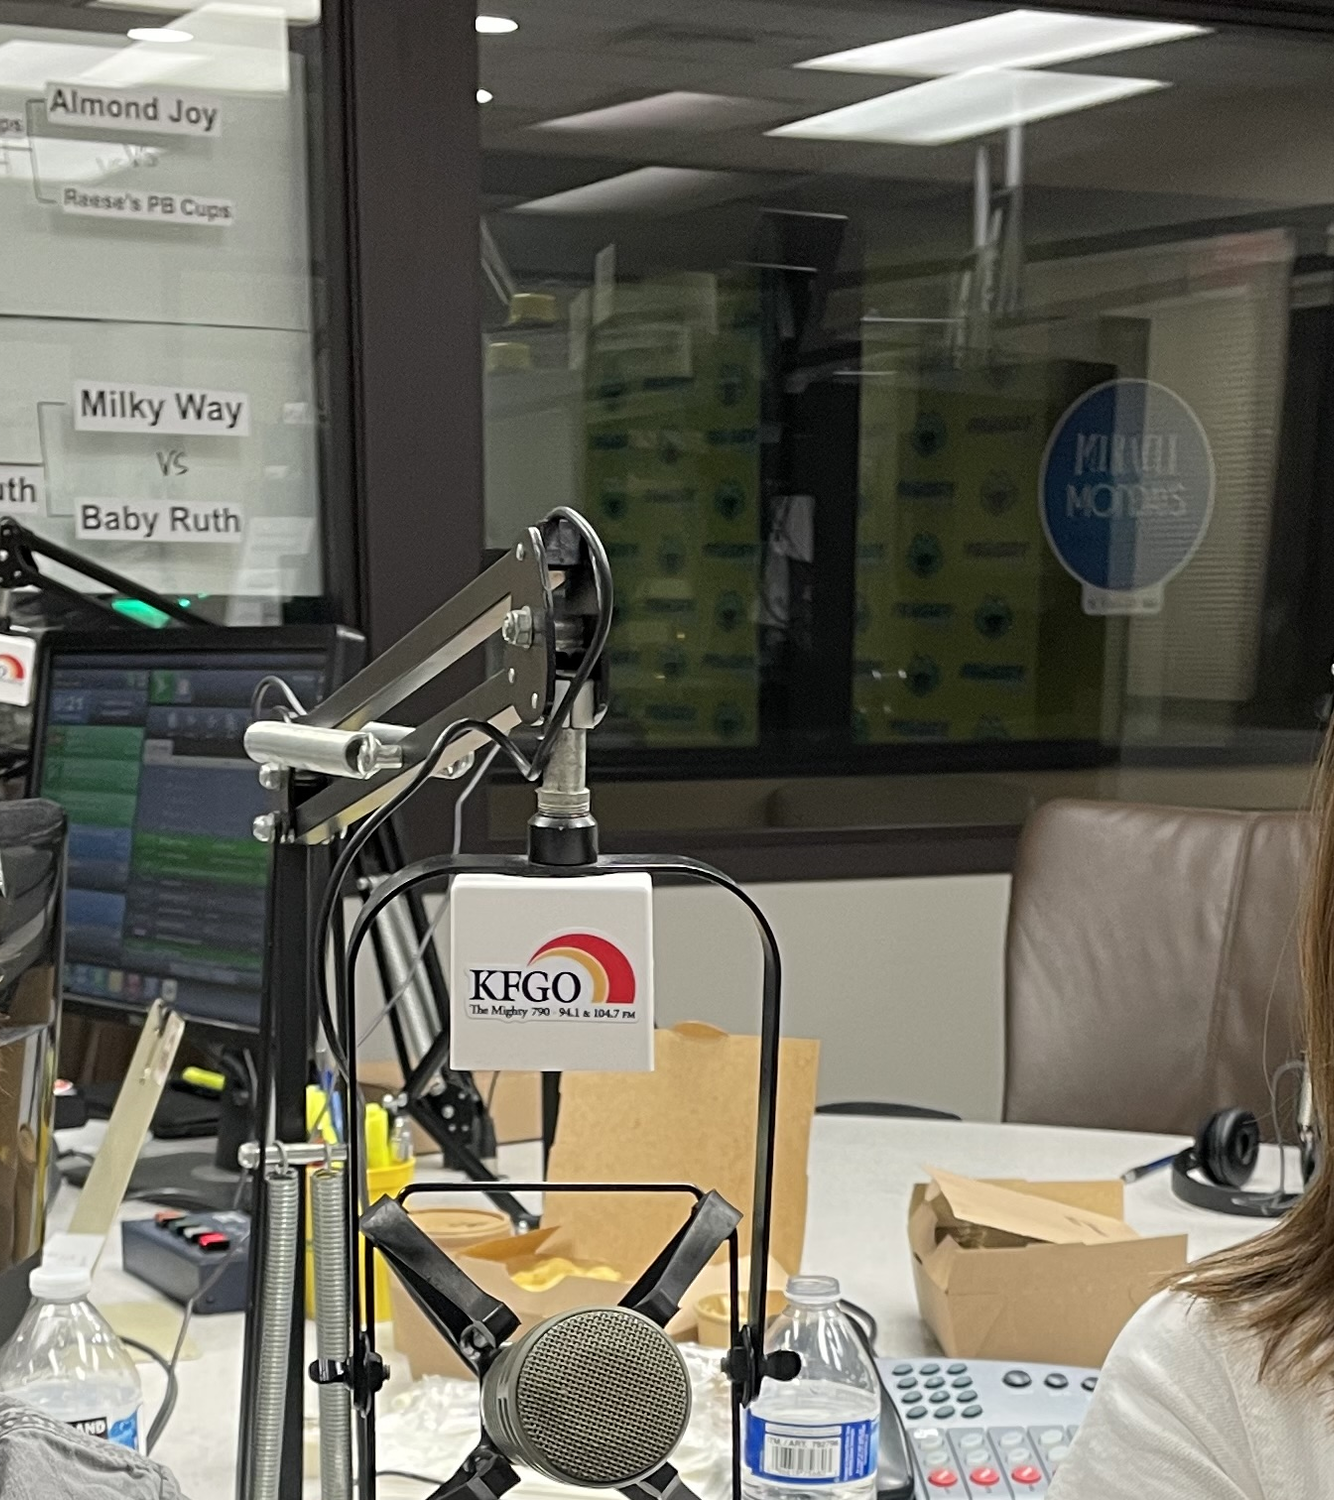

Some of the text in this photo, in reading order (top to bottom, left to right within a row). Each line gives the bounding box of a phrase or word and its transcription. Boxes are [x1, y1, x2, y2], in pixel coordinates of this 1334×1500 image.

[49, 88, 218, 132] Almond Joy
[63, 187, 232, 222] Reese's PB Cups
[80, 389, 242, 429] Milky Way
[81, 504, 242, 538] Baby Ruth
[468, 968, 582, 1004] KFGO
[469, 1004, 489, 1015] The
[491, 1005, 529, 1019] Mighty
[531, 1007, 551, 1016] 790
[559, 1007, 580, 1018] 94.1
[593, 1008, 620, 1019] 104.7
[622, 1011, 636, 1019] FM
